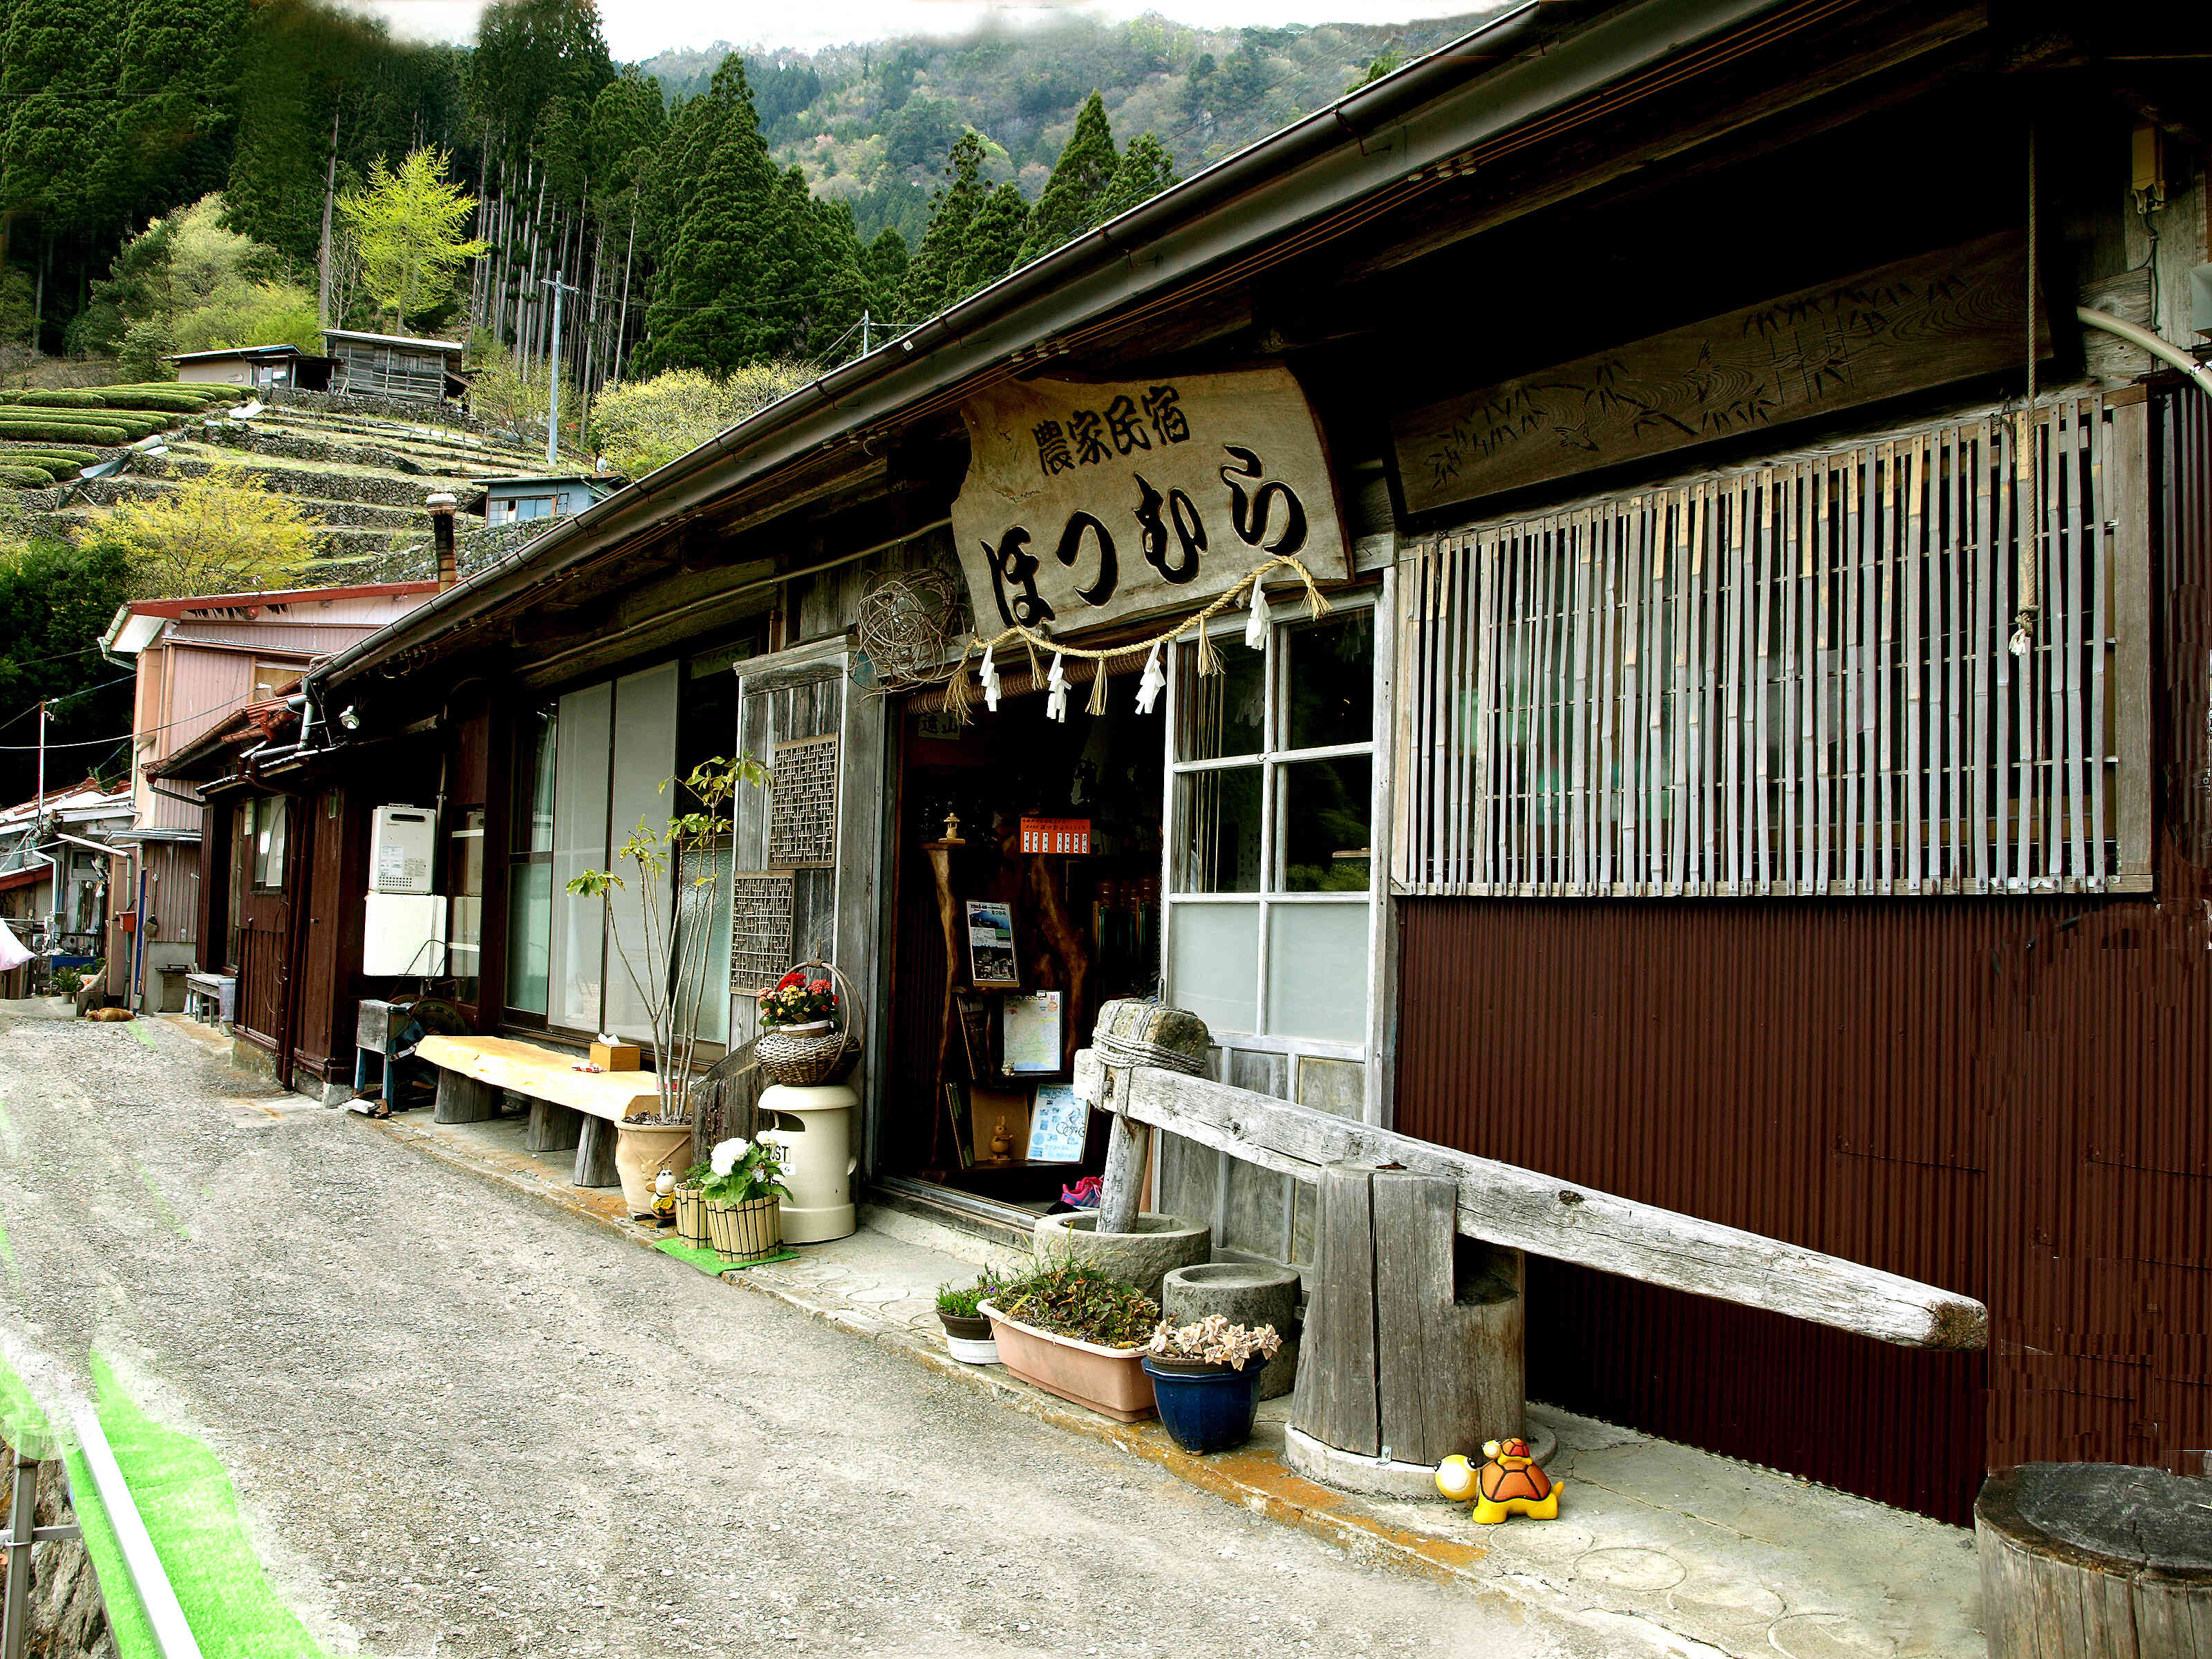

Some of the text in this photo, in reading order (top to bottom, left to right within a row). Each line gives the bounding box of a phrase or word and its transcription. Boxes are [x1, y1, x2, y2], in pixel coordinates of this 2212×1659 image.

[1033, 385, 1190, 476] 農家民宿
[980, 444, 1309, 629] ほつむら
